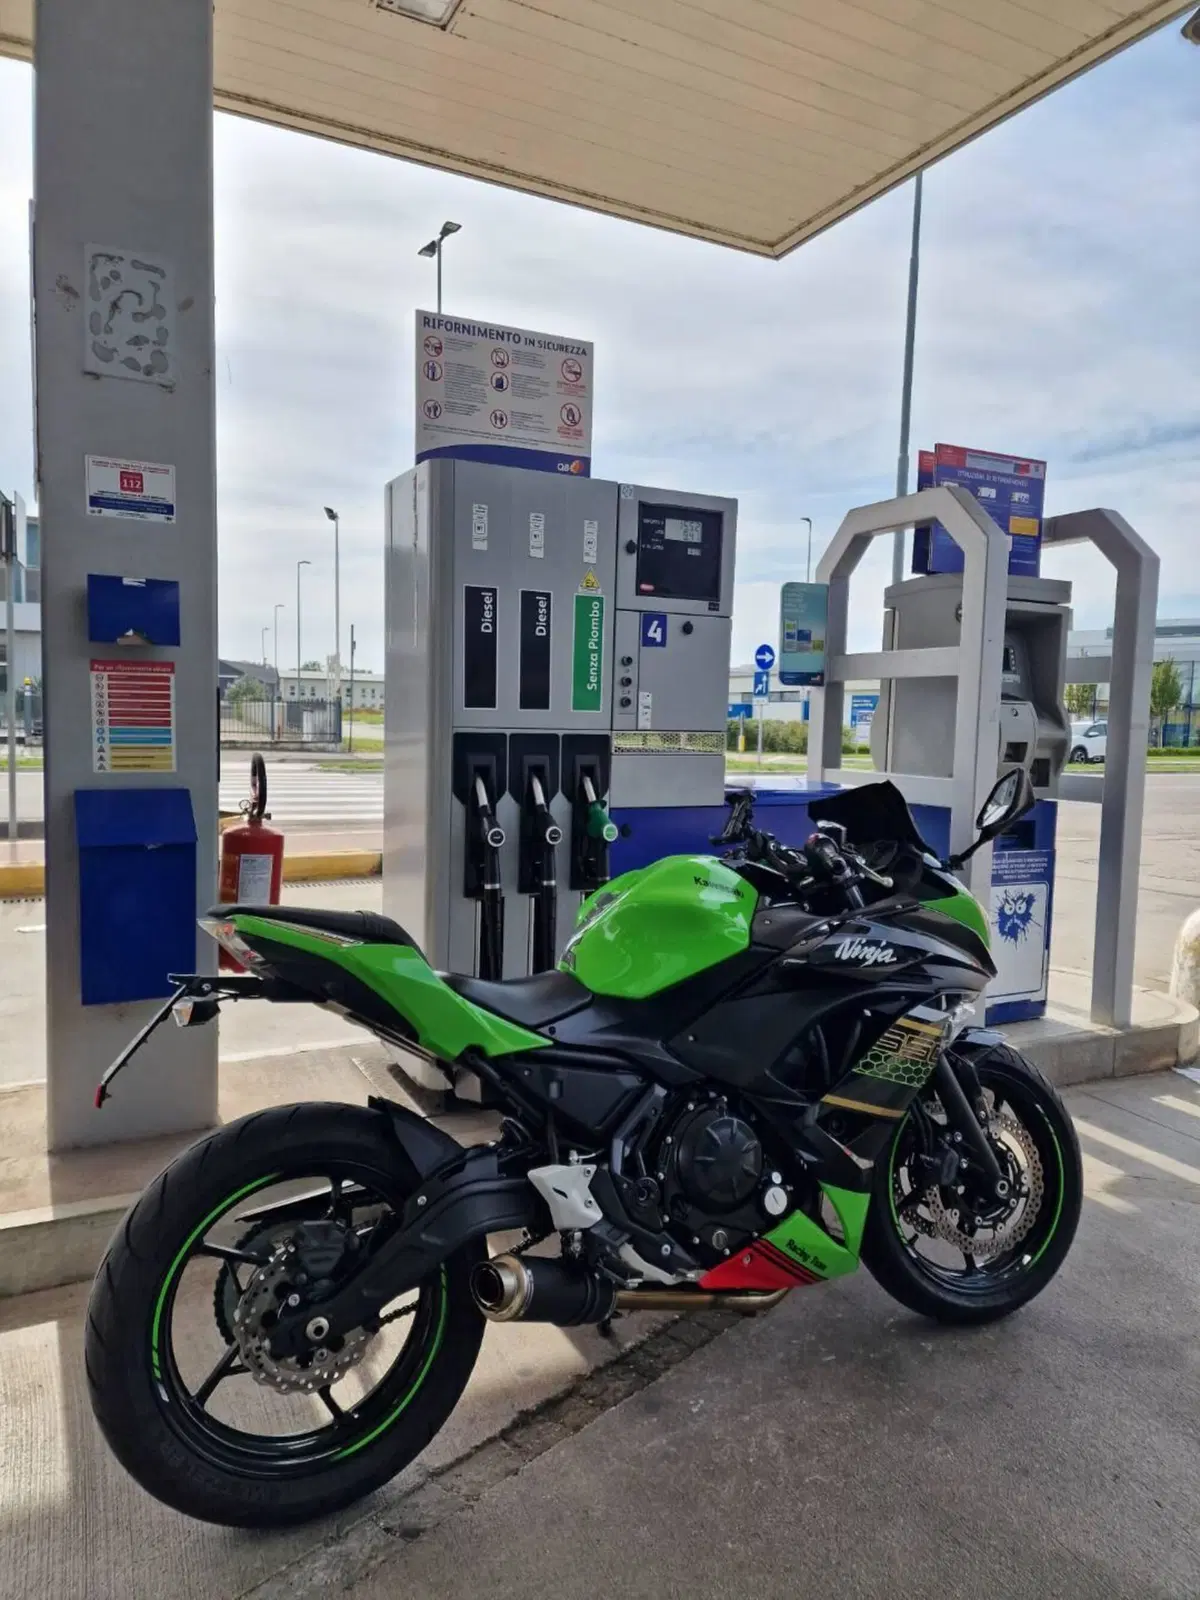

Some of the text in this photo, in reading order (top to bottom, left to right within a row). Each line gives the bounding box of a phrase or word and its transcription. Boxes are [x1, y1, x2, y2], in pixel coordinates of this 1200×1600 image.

[423, 316, 521, 345] RIFORNIMENTO
[524, 337, 535, 348] IN
[537, 340, 587, 356] SICUREZZA
[122, 478, 142, 489] 112
[481, 592, 493, 633] Diesel
[535, 596, 547, 636] Diesel
[647, 619, 662, 643] 4
[587, 601, 600, 691] Senza Piombo
[834, 937, 897, 968] Ninja
